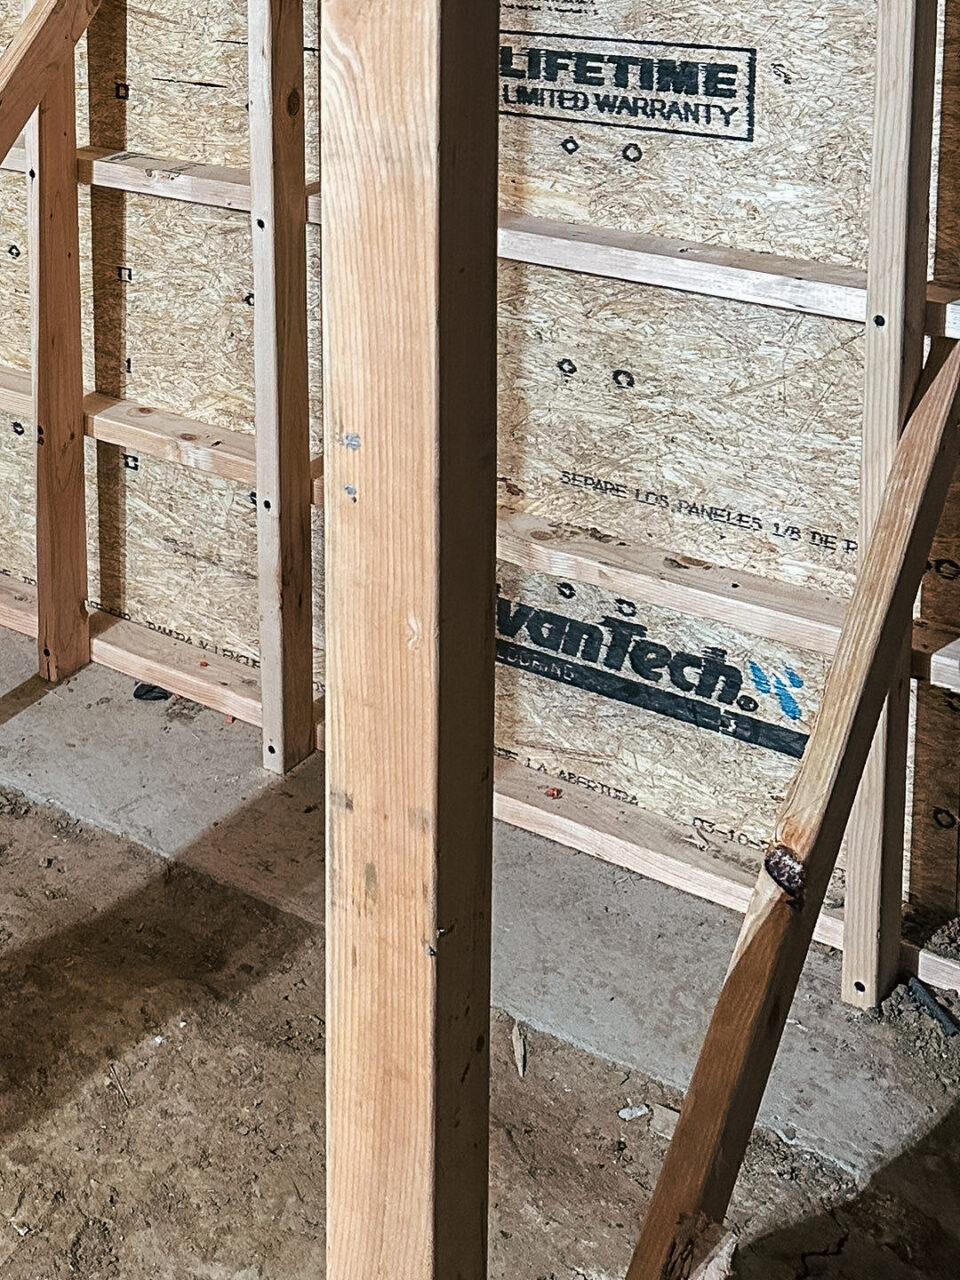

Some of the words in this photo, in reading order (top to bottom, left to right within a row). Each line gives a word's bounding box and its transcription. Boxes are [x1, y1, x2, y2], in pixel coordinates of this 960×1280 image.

[500, 46, 738, 99] LIFETIME
[503, 83, 589, 112] LIMITED
[593, 92, 739, 128] WARRANTY
[561, 470, 627, 499] SEPARE
[635, 489, 669, 509] LOS
[676, 500, 763, 532] PANELES
[772, 521, 802, 542] 1/8
[810, 531, 838, 548] DE
[497, 597, 745, 706] vanTech
[497, 644, 574, 682] LOORING
